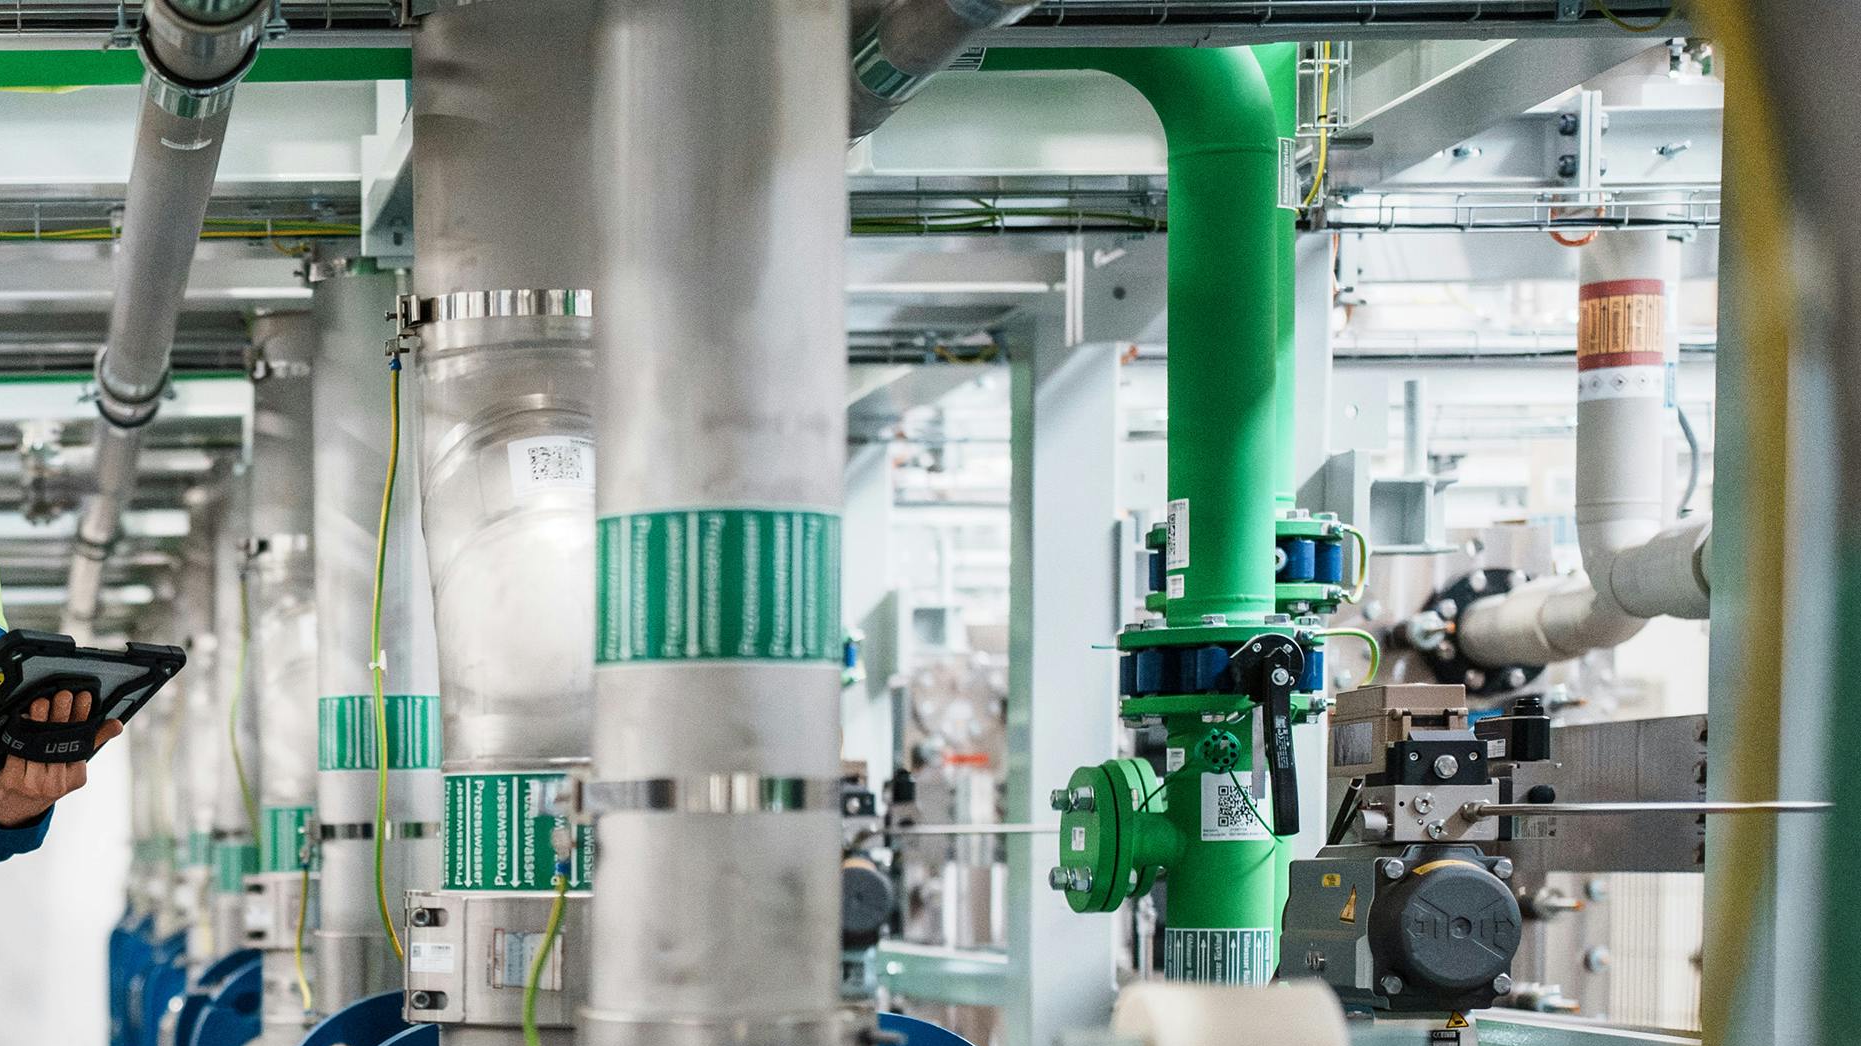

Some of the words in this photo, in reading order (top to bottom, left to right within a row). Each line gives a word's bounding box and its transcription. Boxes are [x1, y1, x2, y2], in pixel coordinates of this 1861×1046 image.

[455, 780, 463, 886] Prozesswasser
[474, 780, 484, 886] Prozesswasser
[494, 779, 507, 886] Prozesswasser
